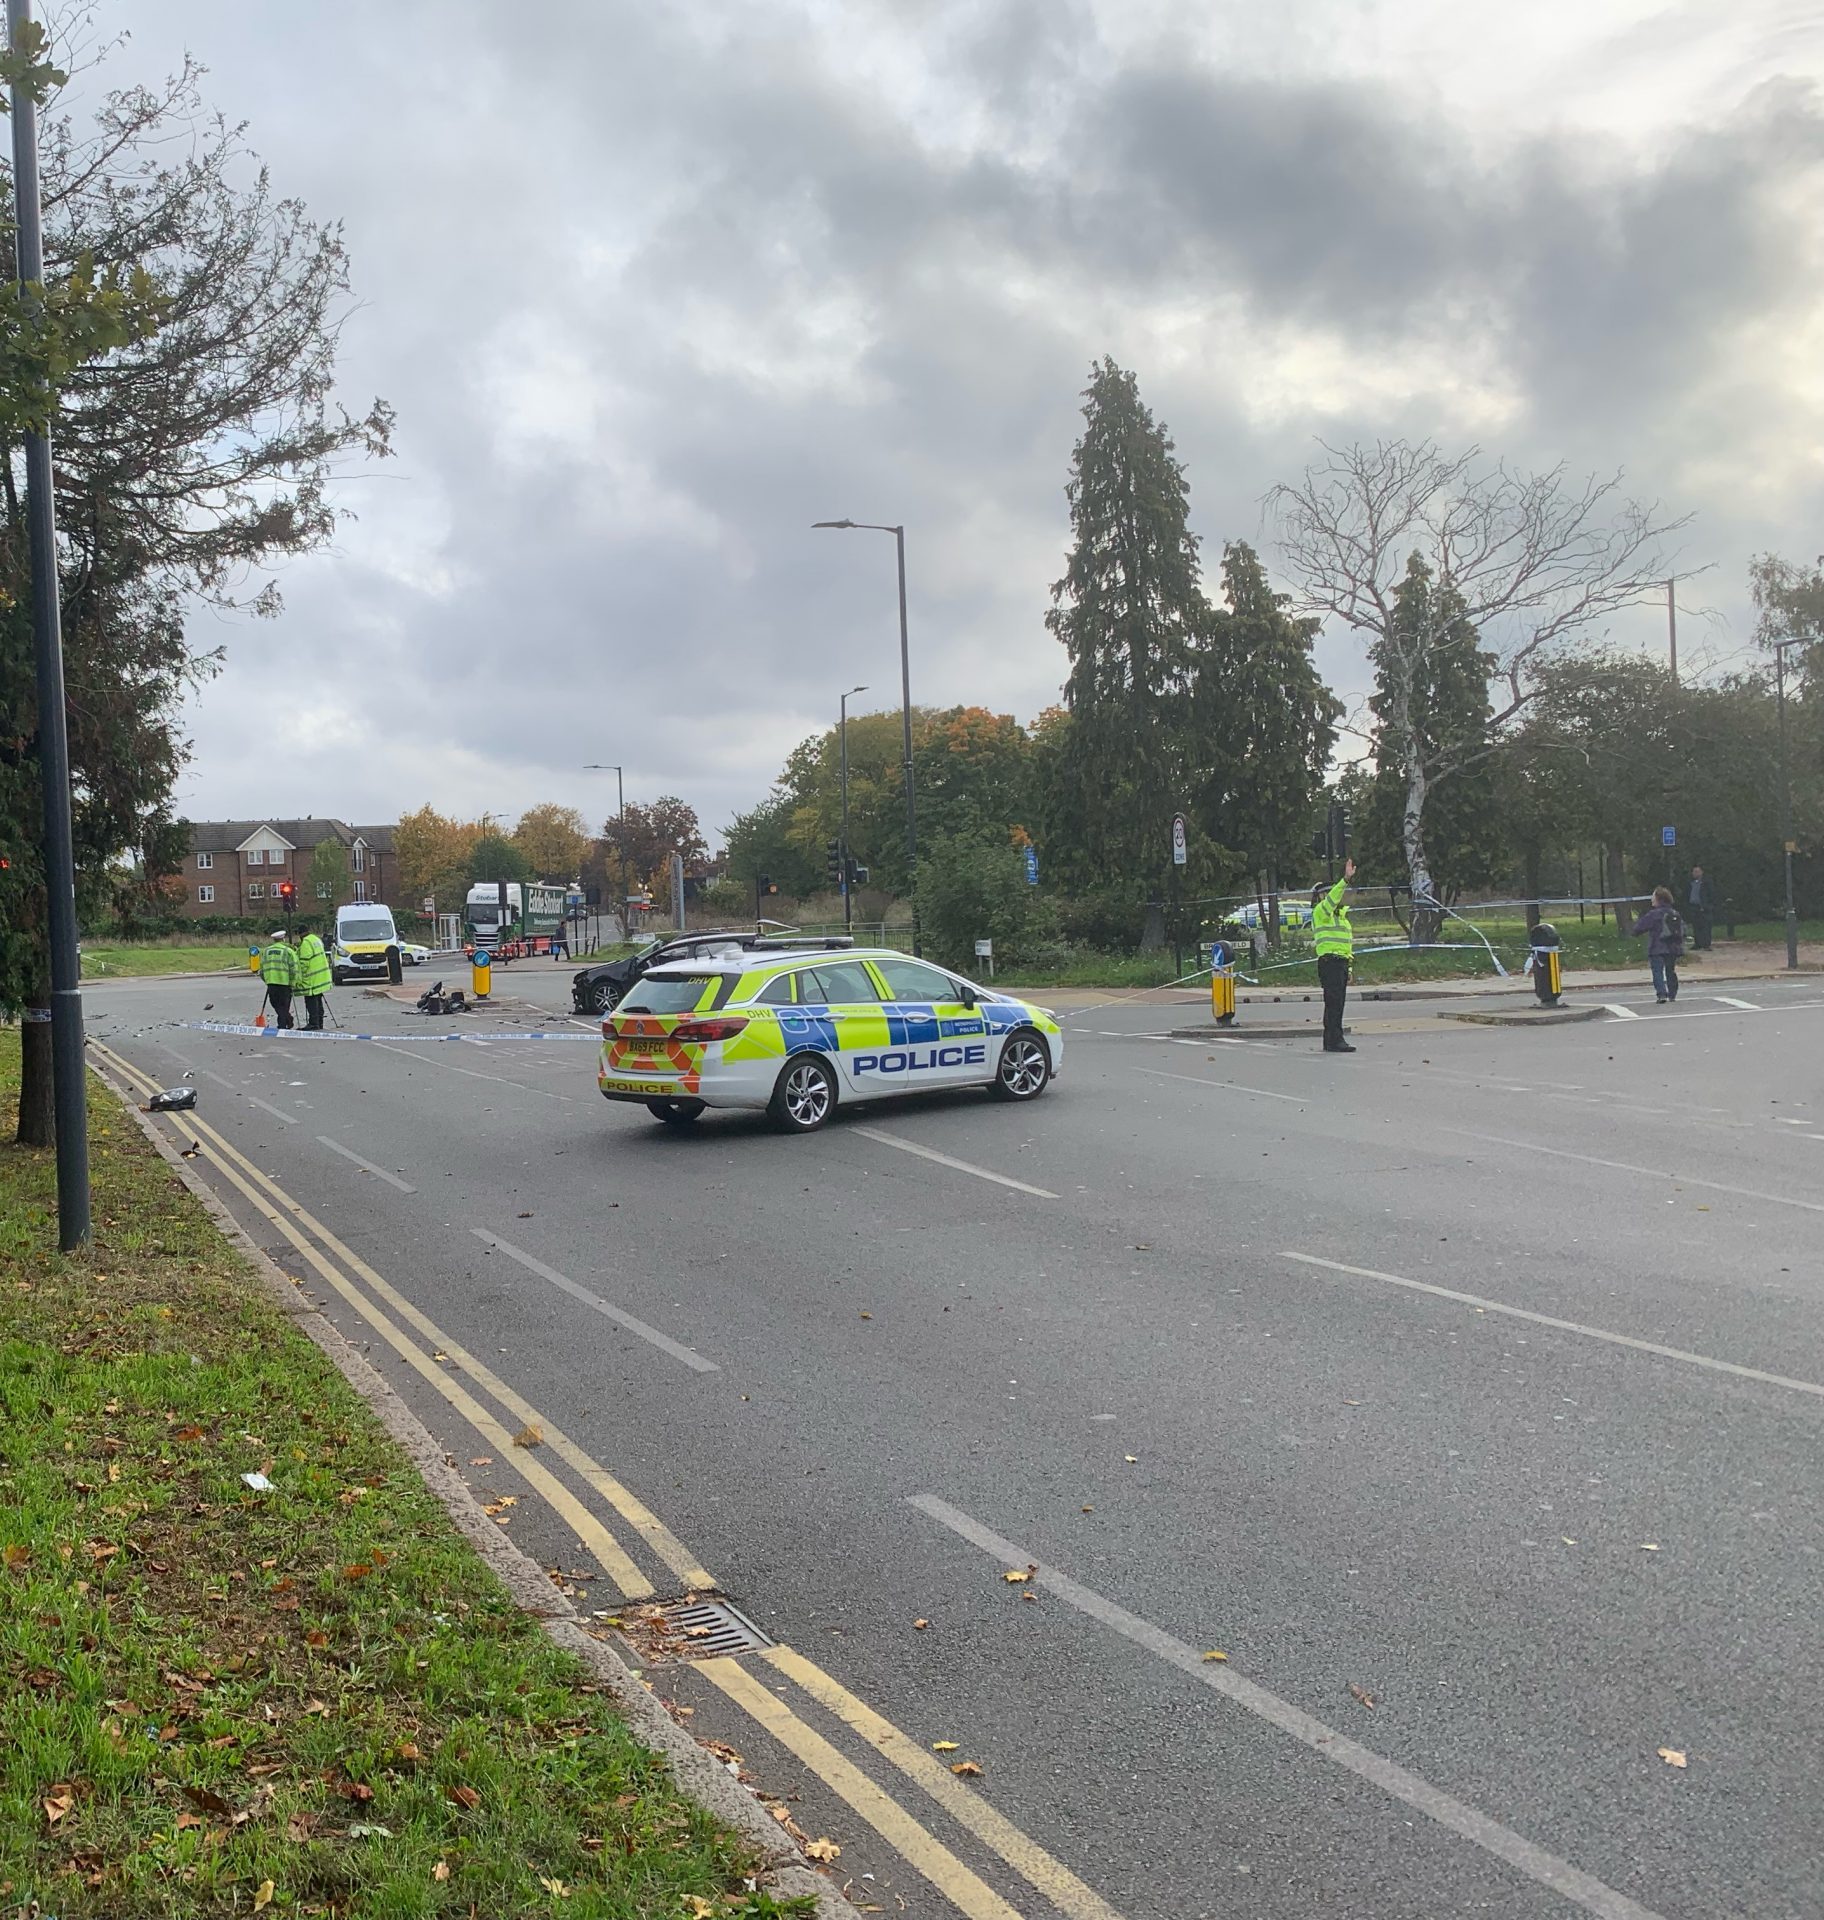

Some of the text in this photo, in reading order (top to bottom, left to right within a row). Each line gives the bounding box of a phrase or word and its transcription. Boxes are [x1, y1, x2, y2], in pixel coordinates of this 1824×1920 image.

[528, 888, 564, 915] Eddie Stobart
[687, 976, 712, 985] DHV
[747, 1009, 771, 1019] DHV
[629, 1040, 665, 1053] BX69 FCC
[853, 1044, 986, 1076] POLICE
[607, 1081, 674, 1094] POLICE
